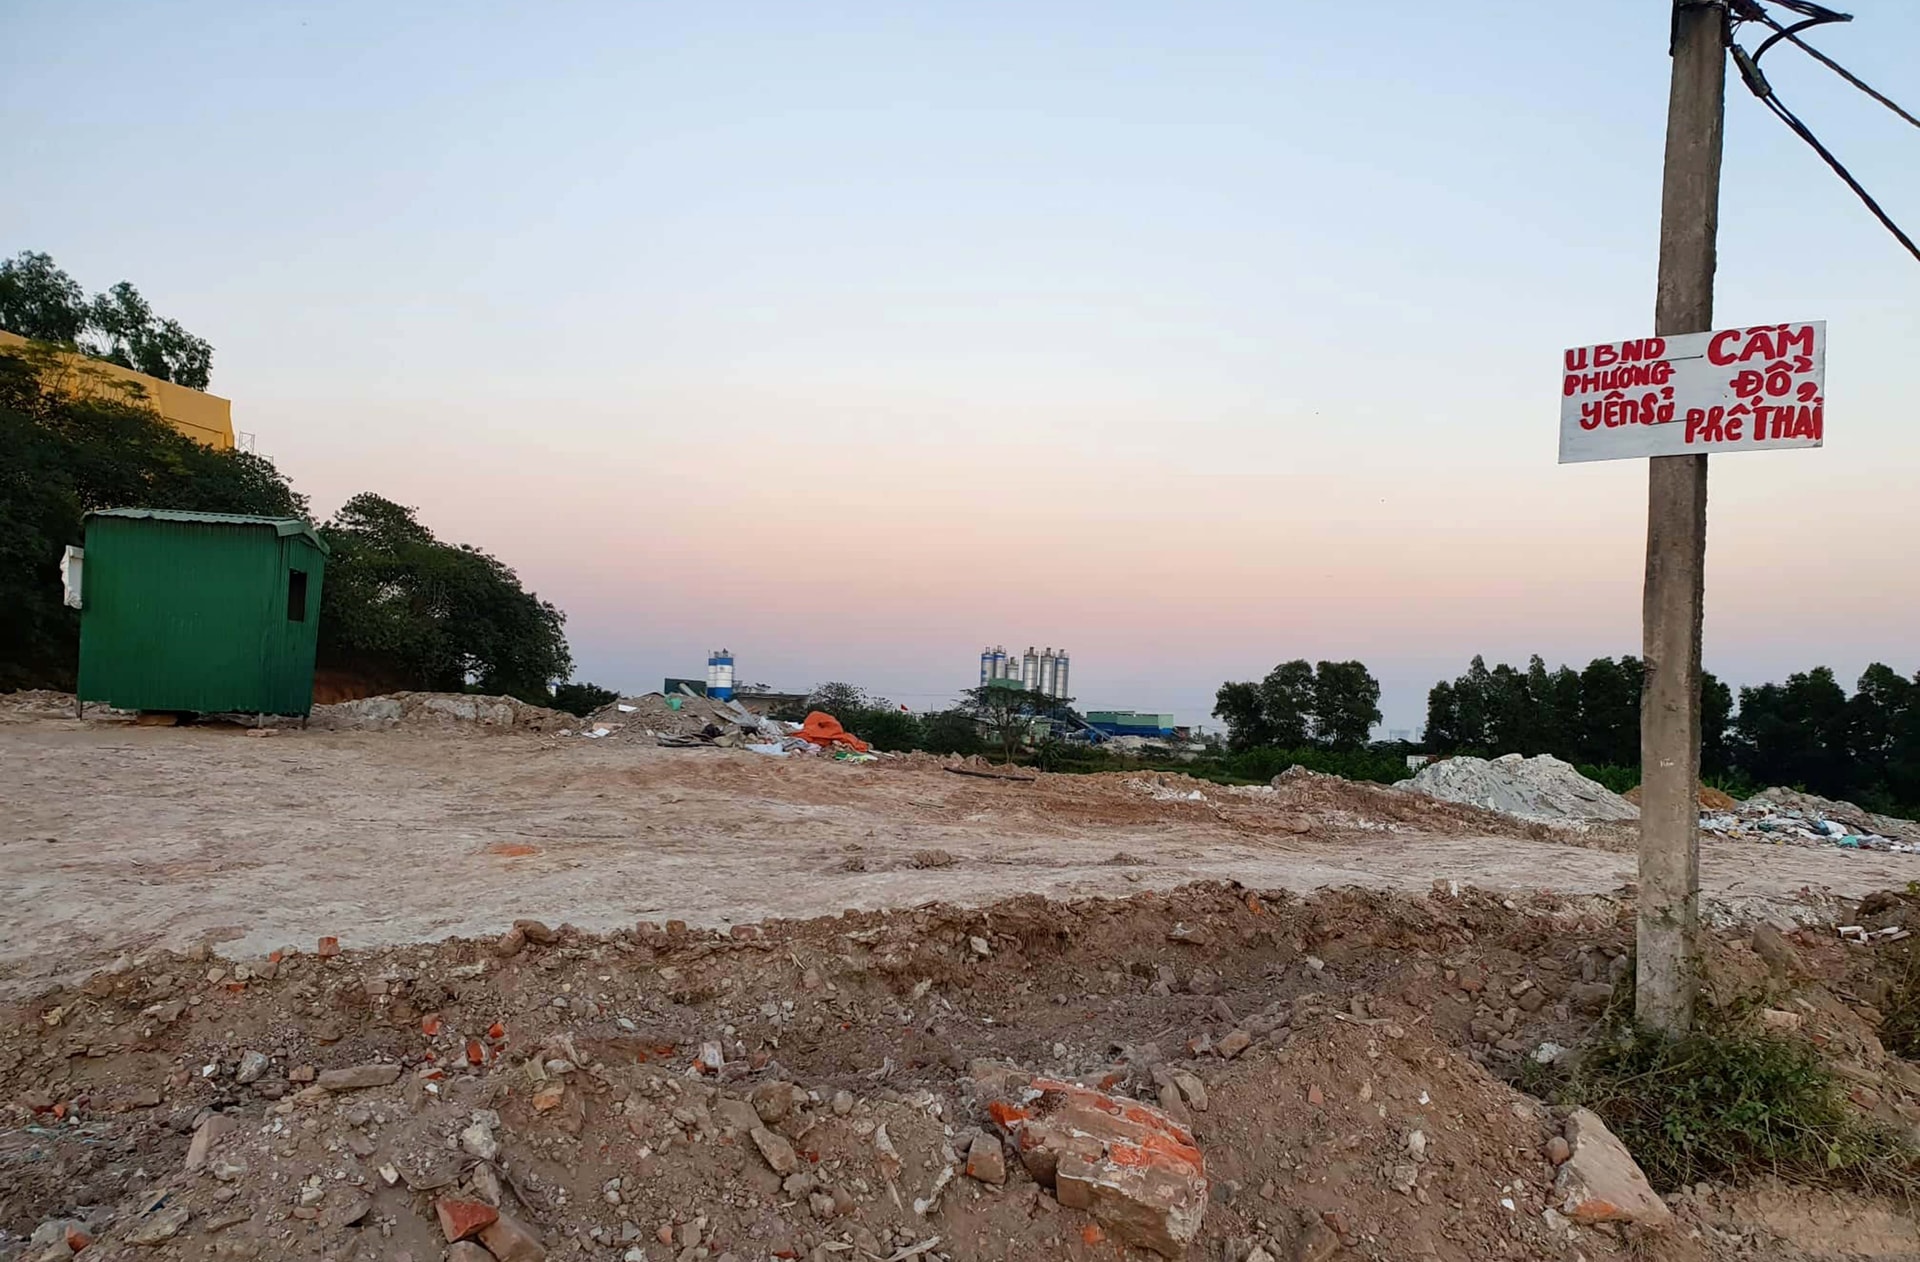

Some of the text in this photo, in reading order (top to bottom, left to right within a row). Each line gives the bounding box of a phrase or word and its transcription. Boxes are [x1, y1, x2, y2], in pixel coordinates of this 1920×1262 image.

[1565, 338, 1666, 371] UBND
[1707, 323, 1815, 367] CẤM
[1729, 355, 1815, 399] ĐỔ
